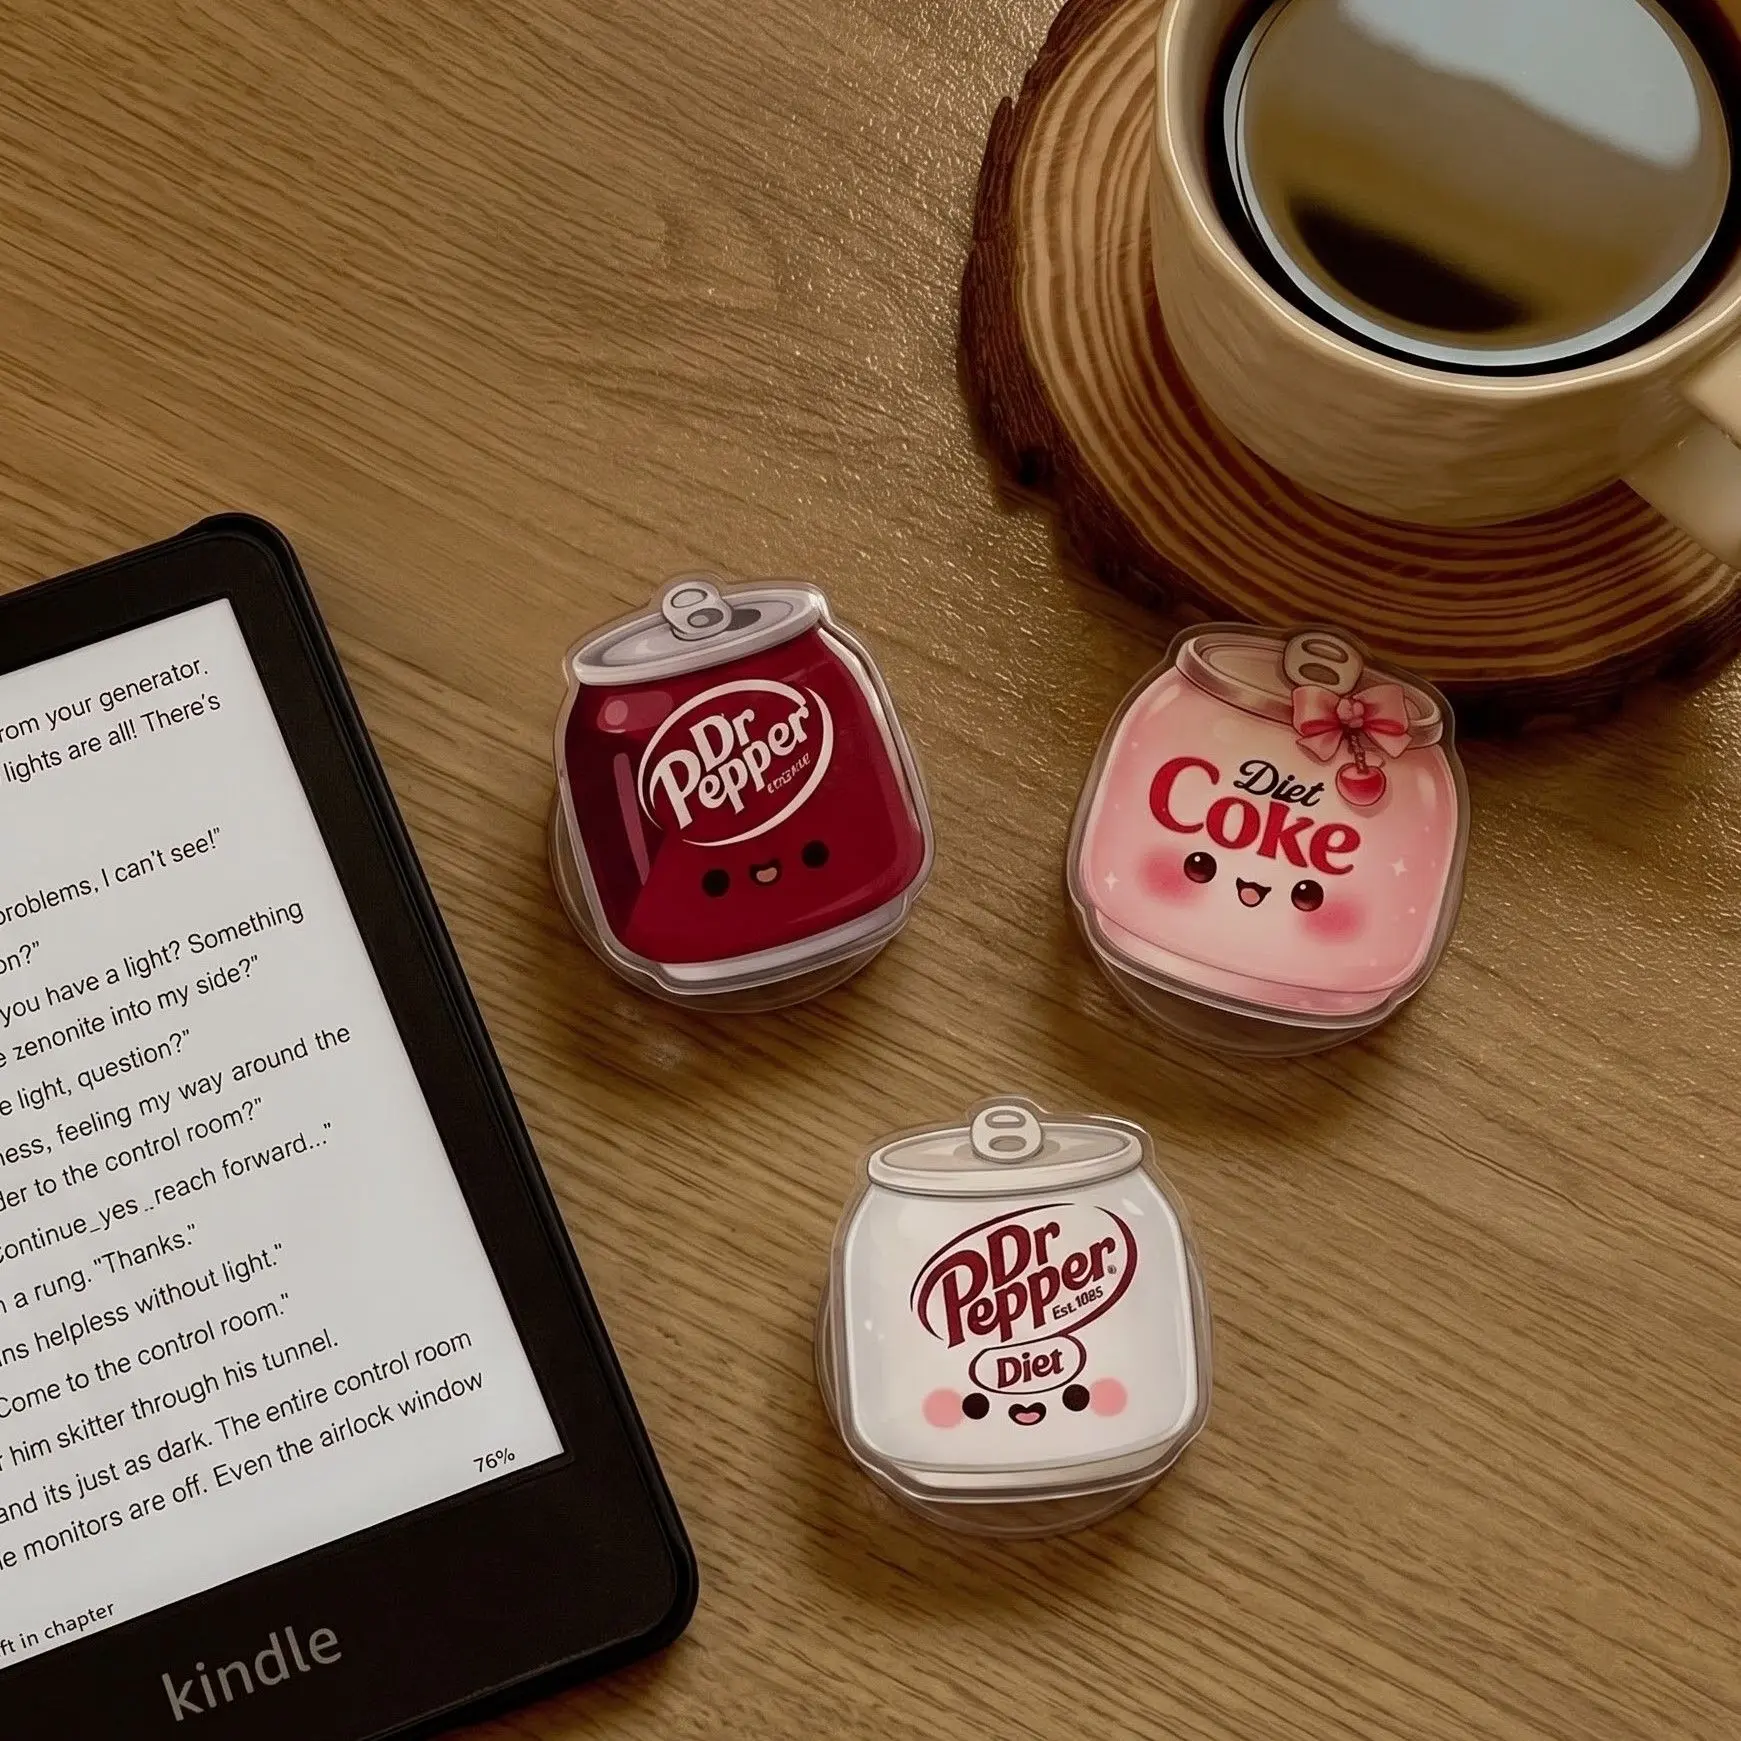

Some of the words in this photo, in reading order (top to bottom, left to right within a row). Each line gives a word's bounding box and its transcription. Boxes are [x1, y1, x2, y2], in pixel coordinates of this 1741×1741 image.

[44, 697, 92, 732] your
[99, 659, 208, 712] generator.
[2, 750, 63, 783] lights
[67, 736, 103, 760] are
[107, 718, 138, 746] all!
[139, 693, 221, 732] There's
[649, 706, 810, 830] Pepper
[688, 708, 755, 773] Dr
[1148, 756, 1361, 876] Coke
[1232, 759, 1325, 807] Diet
[100, 868, 110, 888] I
[114, 849, 167, 883] can't
[0, 995, 41, 1029] you
[44, 975, 100, 1007] have
[105, 968, 121, 985] a
[123, 939, 180, 979] light?
[187, 902, 304, 954] Something
[11, 1016, 106, 1061] zenonite
[109, 999, 152, 1026] into
[156, 984, 188, 1010] my
[16, 1076, 72, 1110] light,
[56, 1106, 132, 1145] feeling
[138, 1090, 170, 1117] my
[177, 1071, 222, 1100] way
[231, 1037, 309, 1082] around
[314, 1027, 351, 1051] the
[33, 1178, 57, 1197] to
[61, 1162, 99, 1187] the
[105, 1127, 181, 1172] control
[0, 1199, 139, 1264] ontinue_yes
[986, 1221, 1061, 1290] Dr
[0, 1342, 30, 1368] ns
[33, 1305, 130, 1353] helpless
[134, 1268, 220, 1314] without
[13, 1291, 30, 1309] a
[33, 1269, 92, 1302] rung.
[917, 1236, 1116, 1350] Pepper
[65, 1372, 90, 1393] to
[94, 1356, 132, 1382] the
[137, 1319, 216, 1366] control
[996, 1348, 1065, 1389] Diet
[8, 1438, 52, 1467] him
[56, 1409, 125, 1449] skitter
[130, 1373, 220, 1420] through
[222, 1360, 258, 1387] his
[261, 1328, 339, 1372] tunnel.
[42, 1483, 72, 1506] its
[75, 1462, 121, 1500] just
[124, 1454, 152, 1476] as
[157, 1430, 213, 1463] dark.
[214, 1412, 261, 1440] The
[266, 1387, 329, 1423] entire
[333, 1350, 410, 1396] control
[414, 1332, 472, 1366] room
[0, 1550, 18, 1571] e
[23, 1510, 124, 1561] monitors
[128, 1494, 166, 1520] are
[172, 1472, 208, 1503] off.
[212, 1453, 273, 1488] Even
[275, 1437, 314, 1463] the
[319, 1404, 395, 1448] airlock
[396, 1372, 482, 1417] window
[472, 1446, 516, 1473] 76%
[18, 1632, 40, 1650] in
[43, 1602, 115, 1640] chapter
[160, 1625, 342, 1722] kindle
